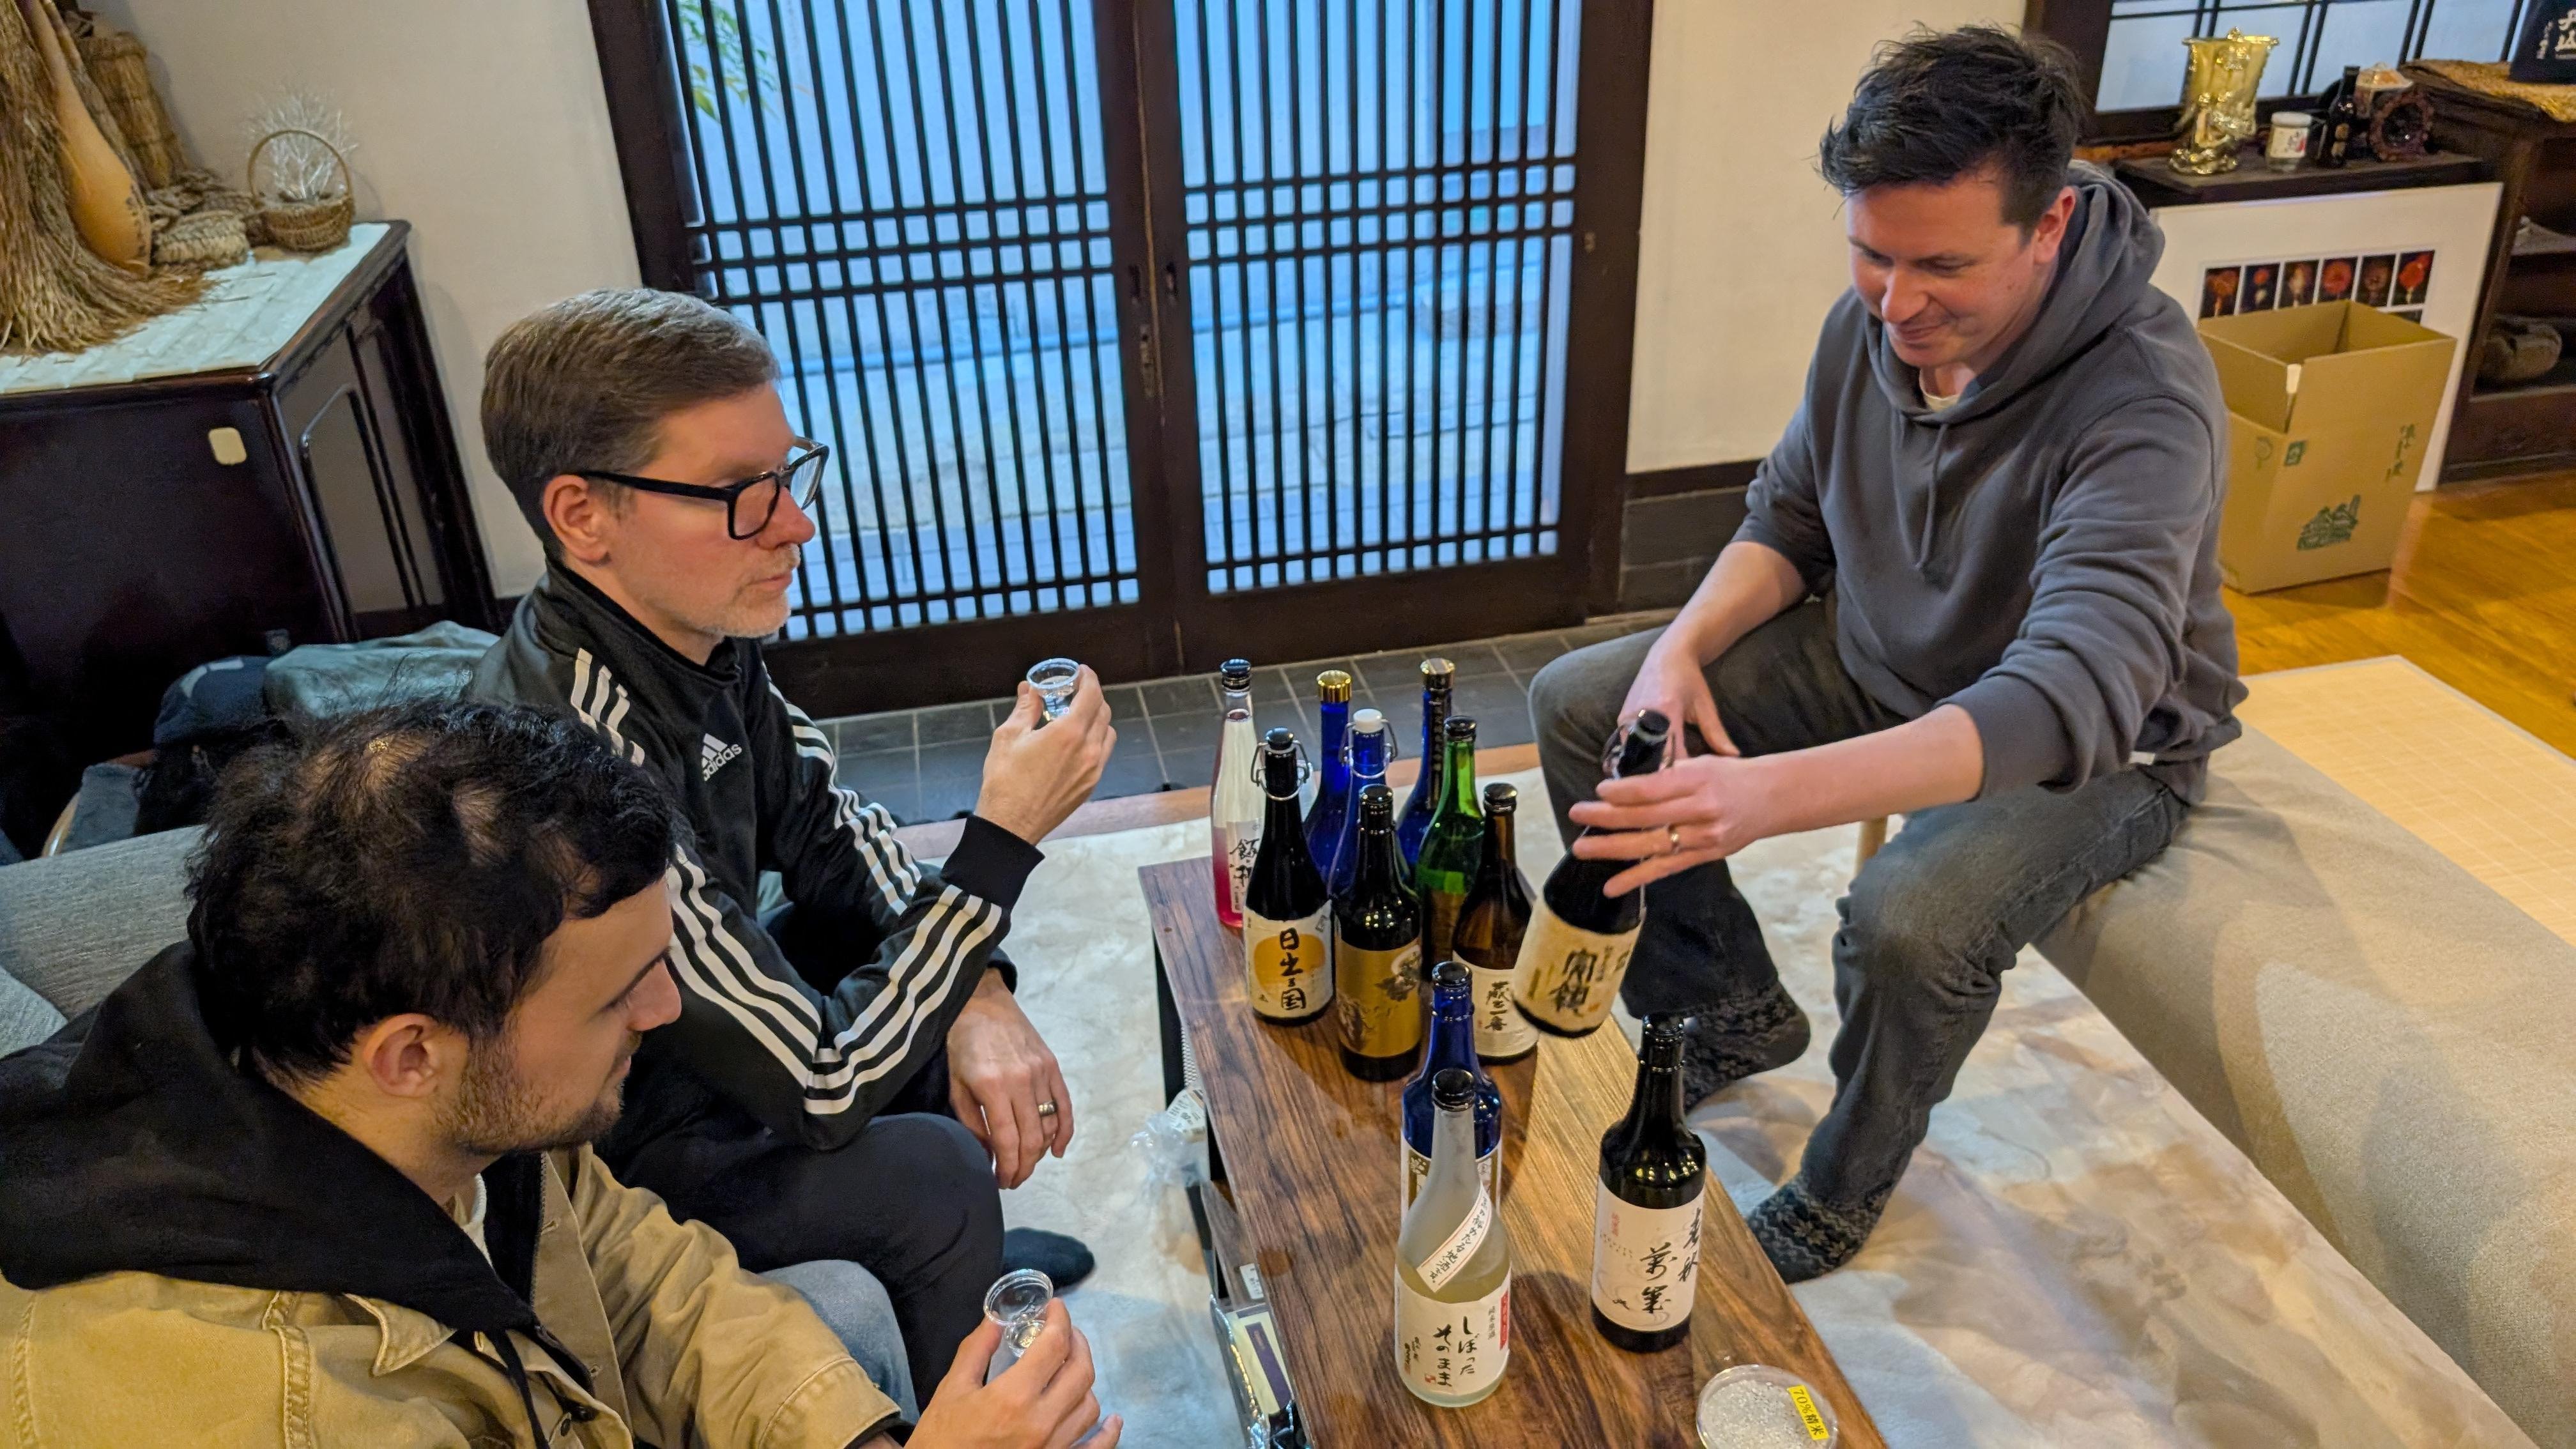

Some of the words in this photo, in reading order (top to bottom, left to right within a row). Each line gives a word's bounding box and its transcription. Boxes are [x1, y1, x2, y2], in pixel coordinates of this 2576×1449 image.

[702, 744, 742, 781] adidas
[1433, 1323, 1453, 1387] そのまま
[1458, 1315, 1480, 1376] しぼった
[1793, 1388, 1825, 1436] 70%精米
